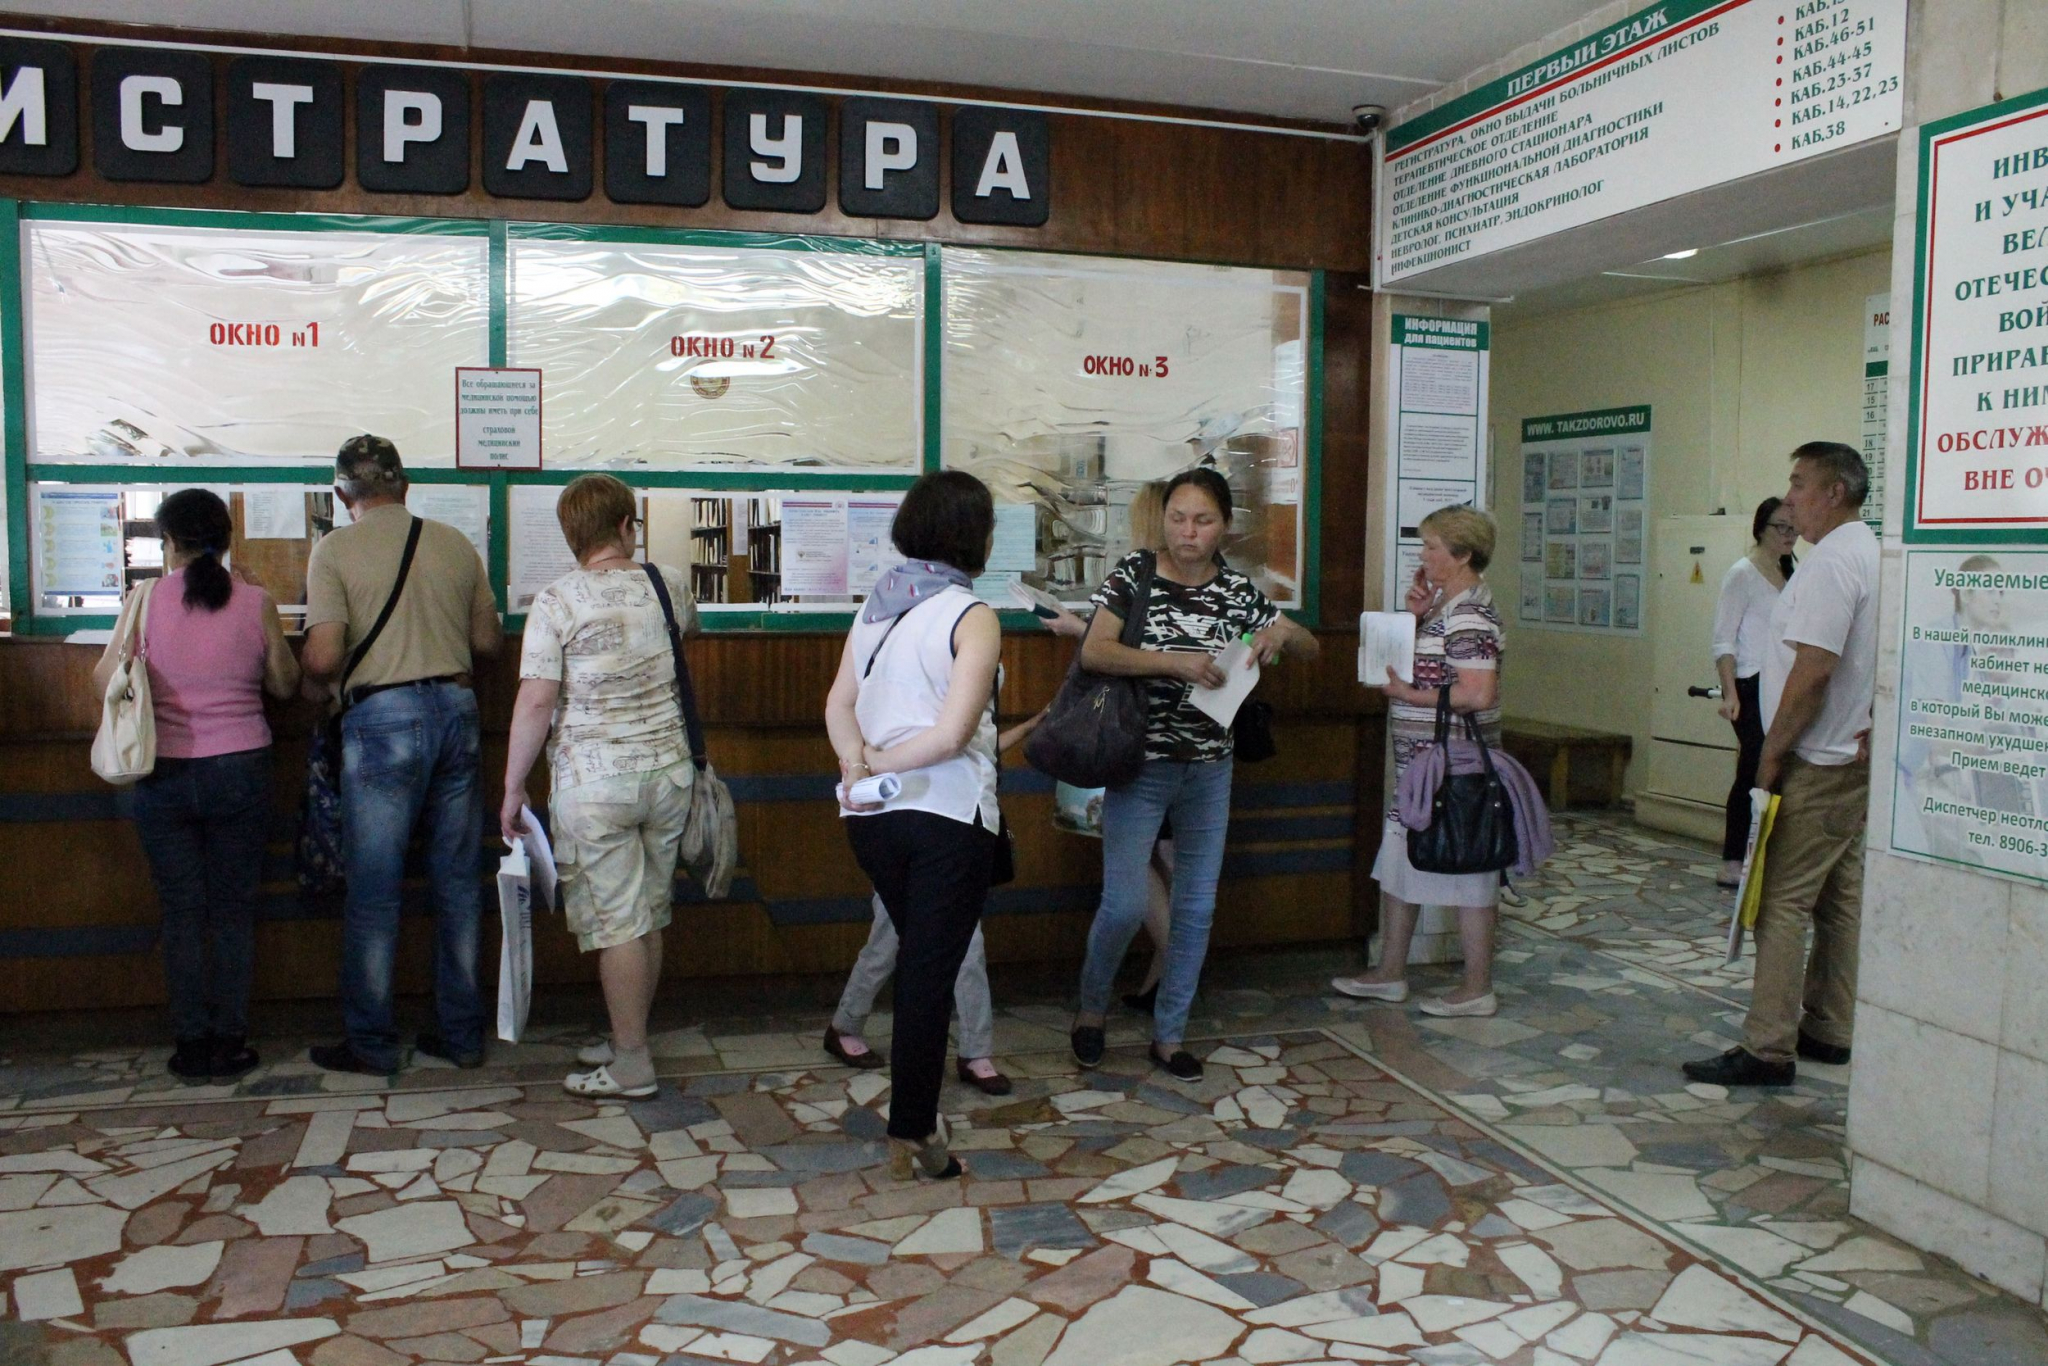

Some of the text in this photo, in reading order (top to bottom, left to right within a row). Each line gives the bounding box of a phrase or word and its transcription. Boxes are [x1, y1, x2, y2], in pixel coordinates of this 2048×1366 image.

[1600, 7, 1669, 53] ЭТАЖ
[1795, 8, 1849, 41] КАБ.12
[1794, 17, 1874, 60] КАБ.46-51
[1792, 41, 1872, 83] КАБ.44-45
[1394, 22, 1720, 172] РЕГИСТРАТУРА, ОКНО ВЫДАЧИ БОЛЬНИЧНЫХ ЛИСТОВ
[1791, 63, 1872, 104] КАБ.23-37
[0, 65, 1031, 200] ИСТРАТУРА
[1792, 121, 1845, 150] КАБ.38
[1392, 101, 1663, 216] ОТДЕЛЕНИЕ ФУНКЦИОНАЛЬНОЙ ДИАГНОСТИКИ
[1393, 113, 1593, 201] ОТДЕЛЕНИЕ ДНЕВНОГО СТАЦИОНАРА
[1394, 111, 1558, 186] ТЕРАПЕВТИЧЕСКОЕ ОТДЕЛЕНИЕ
[1392, 127, 1649, 230] КЛИНИКО-ДИАГНОСТИЧЕСКАЯ ЛАБОРАТОРИЯ
[1505, 180, 1605, 223] ЭНДОКРИНОЛОГ
[1975, 200, 1992, 223] И
[1391, 192, 1519, 245] ДЕТСКАЯ КОНСУЛЬТАЦИЯ
[1391, 240, 1471, 275] ИНФЕКЦИОНИСТ
[210, 322, 280, 346] ОКНО
[1404, 317, 1477, 336] ИНФОРМАЦИЯ
[671, 335, 734, 358] ОКНО
[1404, 333, 1477, 348] для пациентов
[1083, 355, 1134, 376] ОКНО
[462, 379, 473, 388] Все
[1977, 385, 2048, 412] К НИ
[1557, 412, 1645, 433] TAKZDOROVO.RU
[1964, 467, 2048, 491] ВНЕ О
[1934, 568, 2048, 590] Уважаемые
[1912, 626, 2048, 648] В нашей поликлин
[1970, 655, 2030, 673] кабинет
[1910, 701, 1918, 711] в
[1921, 701, 1980, 719] который
[1984, 706, 2005, 721] Вы
[1910, 724, 1985, 744] внезапном
[1952, 751, 2046, 779] Прием ведет
[1923, 797, 1997, 824] Диспетчер
[1968, 831, 1995, 847] тел.
